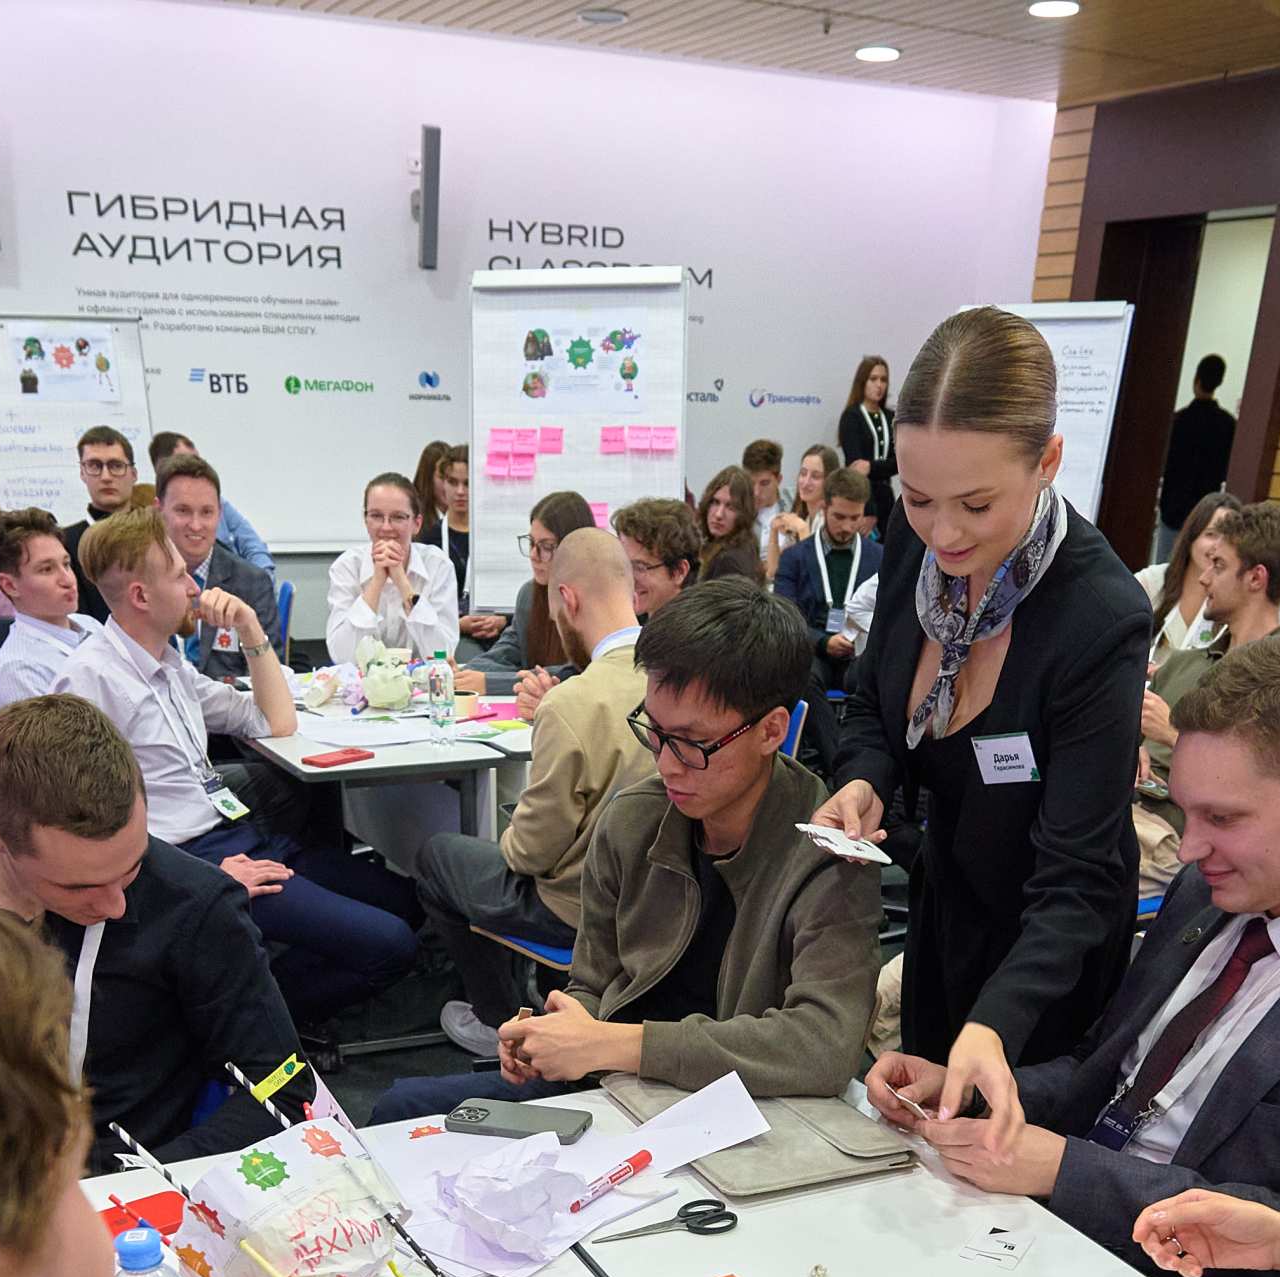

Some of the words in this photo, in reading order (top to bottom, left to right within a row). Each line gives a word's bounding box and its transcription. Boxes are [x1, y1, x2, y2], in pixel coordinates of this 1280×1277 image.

[67, 190, 346, 231] ГИБРИДНАЯ
[488, 218, 625, 249] HYBRID
[72, 232, 342, 269] АУДИТОРИЯ
[209, 373, 249, 394] ВТБ
[993, 752, 1020, 764] Дарья
